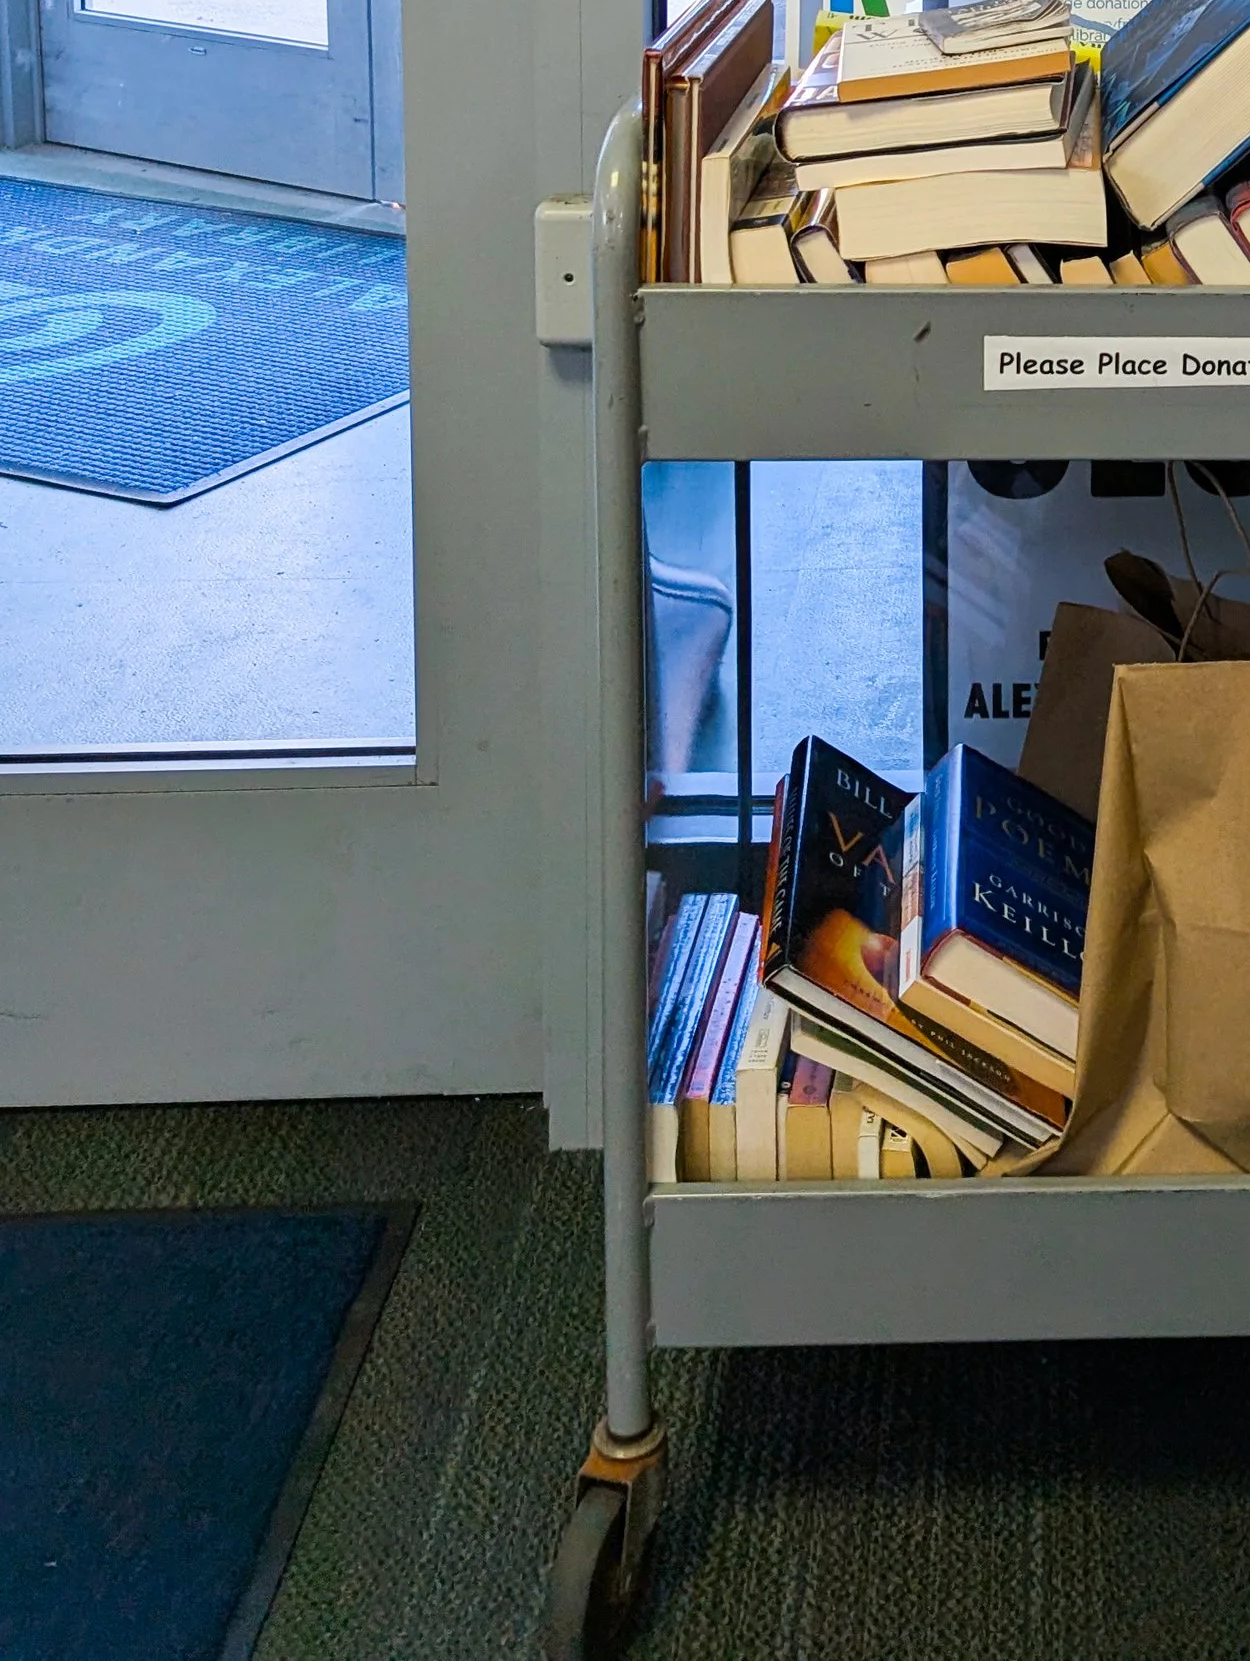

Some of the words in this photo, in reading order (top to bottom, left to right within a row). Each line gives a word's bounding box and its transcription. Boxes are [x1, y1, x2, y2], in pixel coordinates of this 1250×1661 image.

[999, 351, 1085, 376] Please
[1098, 351, 1168, 376] Place
[836, 768, 893, 819] BILL
[976, 795, 1091, 886] POEM
[972, 880, 1085, 962] KEILL
